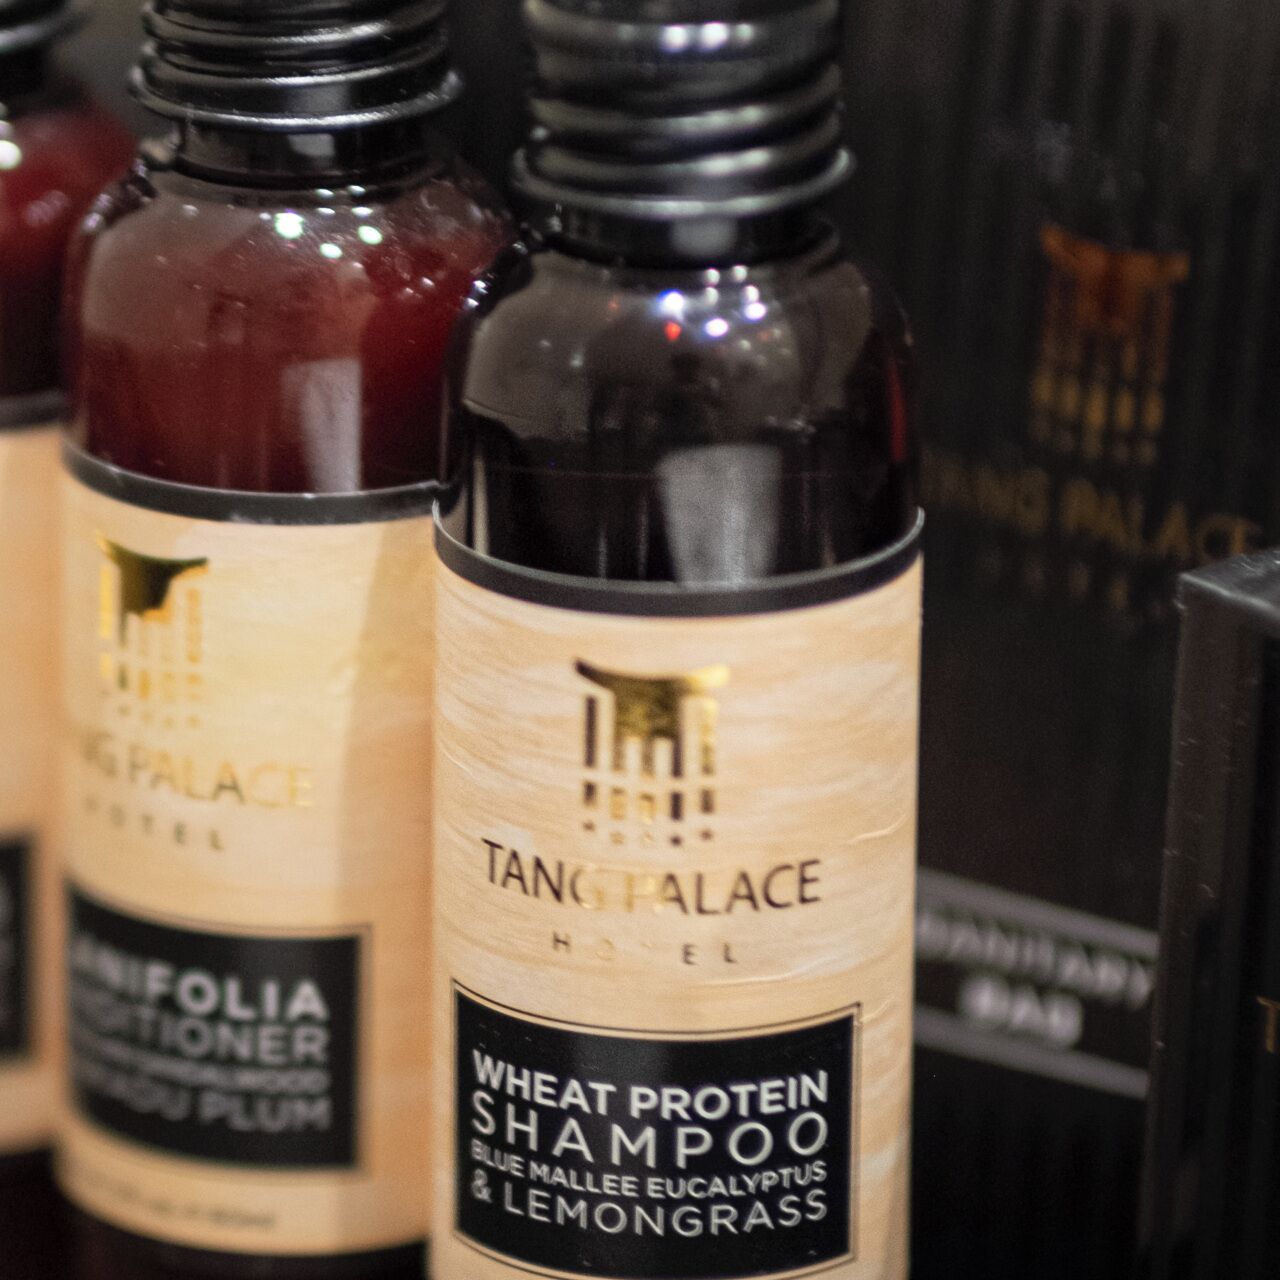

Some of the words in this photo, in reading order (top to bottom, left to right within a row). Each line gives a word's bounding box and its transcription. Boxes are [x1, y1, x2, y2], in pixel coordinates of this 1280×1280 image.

[127, 742, 313, 812] PALACE
[482, 838, 606, 910] TANG
[625, 859, 822, 916] PALACE
[553, 932, 738, 966] HOEL
[199, 1088, 332, 1132] PLUM
[472, 1048, 616, 1116] WHEAT
[629, 1069, 829, 1121] PROTEIN
[471, 1090, 829, 1169] SHAMPOO
[471, 1138, 526, 1177] BLUE
[529, 1161, 639, 1197] MALLEE
[646, 1160, 828, 1199] EUCALYPTUS
[471, 1168, 493, 1203] &
[503, 1181, 828, 1238] LEMONGRASS
